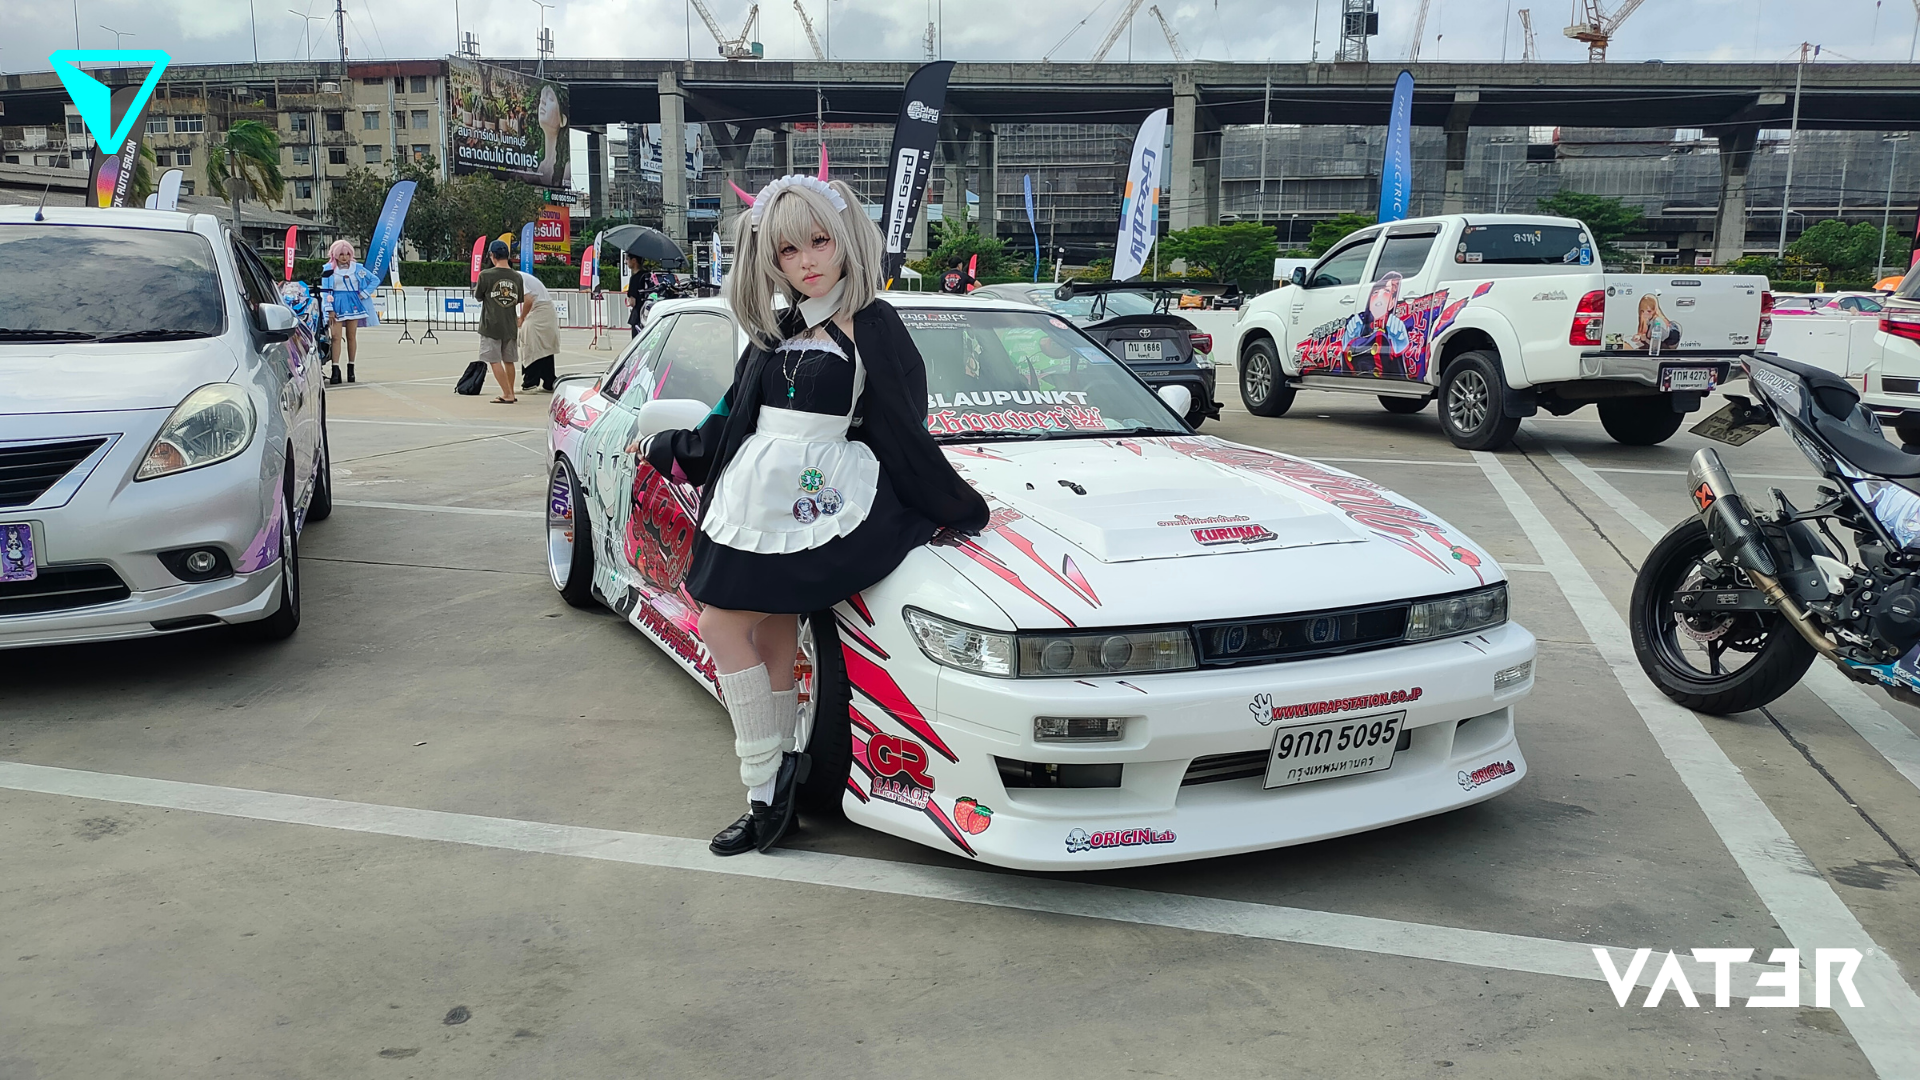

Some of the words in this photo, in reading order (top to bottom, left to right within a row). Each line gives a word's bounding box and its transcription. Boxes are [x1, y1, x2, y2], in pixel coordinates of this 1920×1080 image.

[122, 139, 137, 171] SALON
[117, 170, 130, 195] AUTO
[891, 199, 905, 247] Solar
[898, 154, 914, 198] Gard
[1689, 370, 1708, 381] 4273
[1193, 525, 1266, 542] KURUMA
[1271, 687, 1423, 721] WWW.WRAPSTATION.CO.JP
[1337, 717, 1399, 751] 5095
[1471, 762, 1503, 784] ORIGIN
[872, 776, 931, 803] GARAGE
[1090, 827, 1151, 848] ORIGIN
[1151, 830, 1176, 843] Lab
